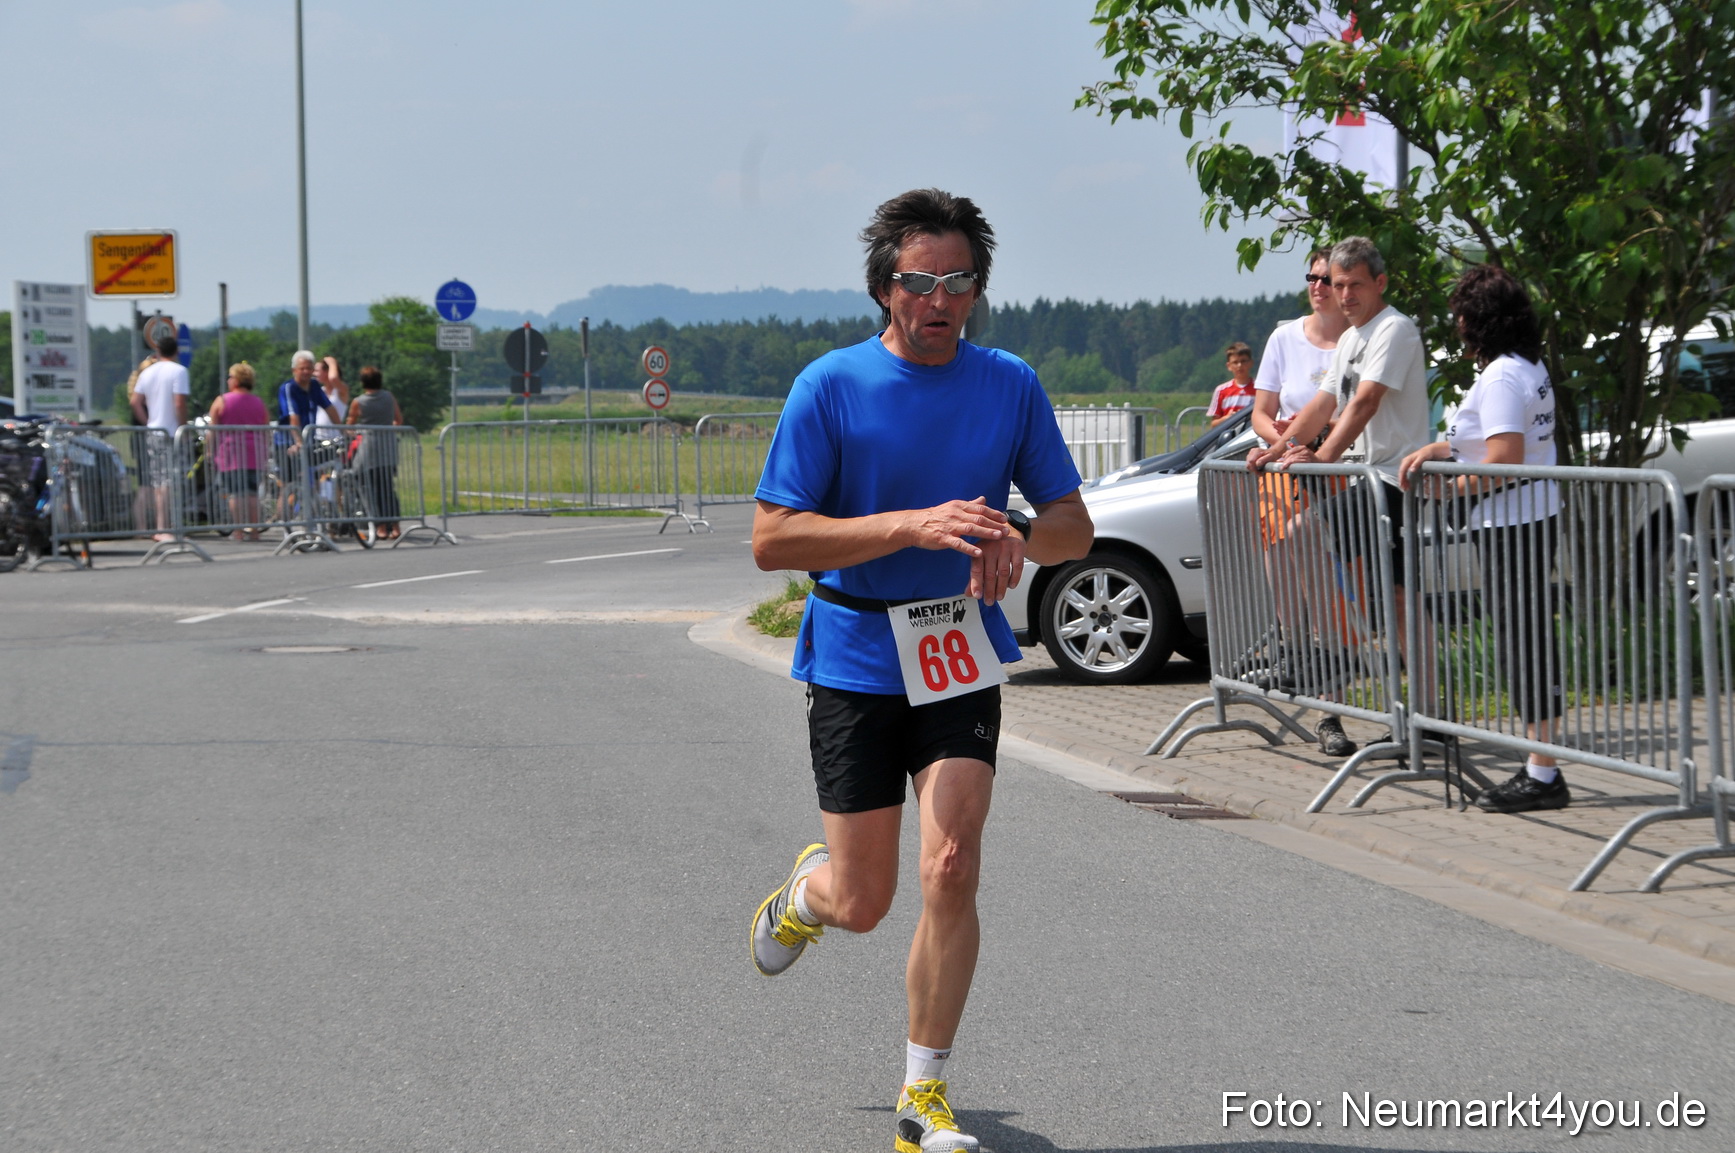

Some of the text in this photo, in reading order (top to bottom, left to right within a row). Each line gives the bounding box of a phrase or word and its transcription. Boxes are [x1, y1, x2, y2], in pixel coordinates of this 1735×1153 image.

[650, 355, 664, 369] 60
[908, 602, 951, 620] MEYER
[909, 614, 951, 629] WERBUNG
[918, 629, 980, 692] 68
